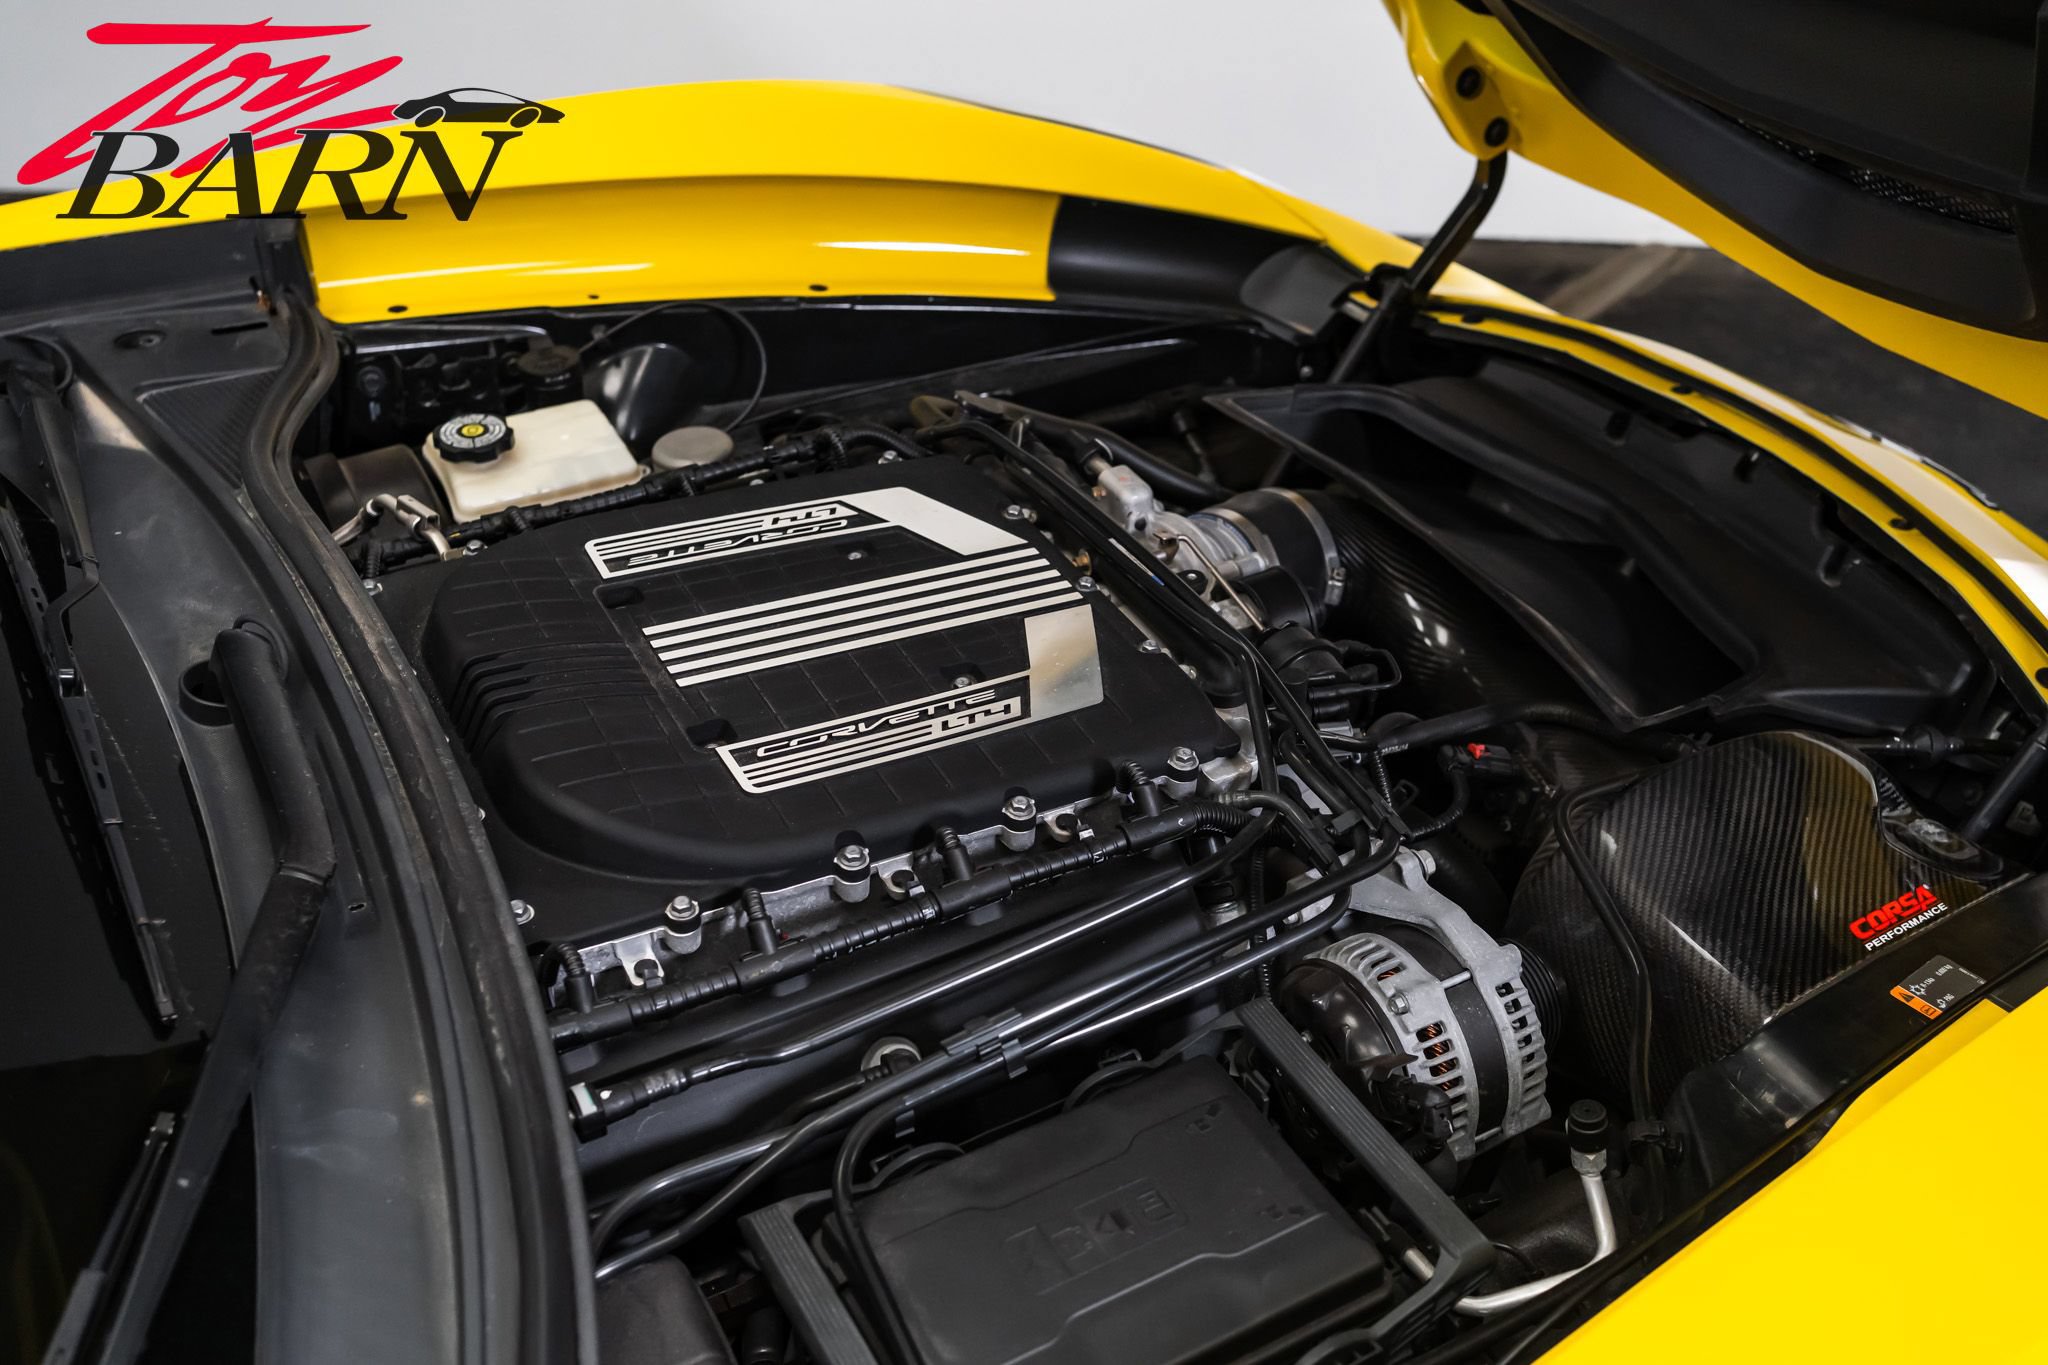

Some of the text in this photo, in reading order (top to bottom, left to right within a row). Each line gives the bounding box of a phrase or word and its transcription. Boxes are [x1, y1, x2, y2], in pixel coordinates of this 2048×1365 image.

[770, 506, 838, 526] LT4
[627, 518, 849, 567] CORVETTE
[756, 689, 997, 758] CORVETTE
[940, 703, 1013, 729] LT4
[1849, 884, 1938, 941] CORSA
[1864, 902, 1949, 952] PERFORMANCE
